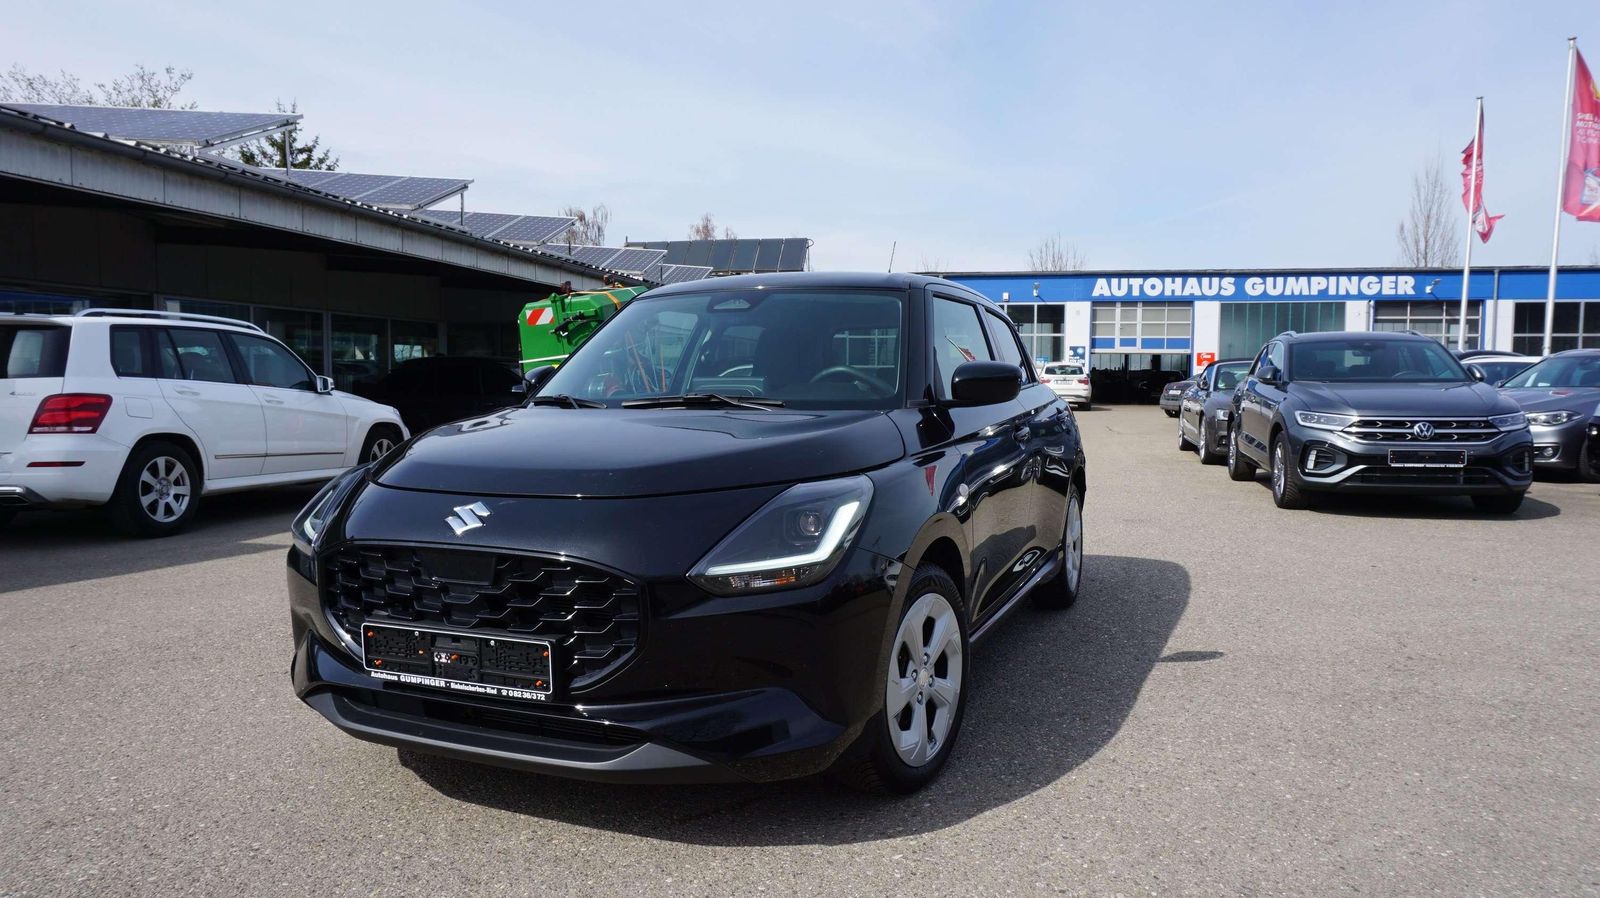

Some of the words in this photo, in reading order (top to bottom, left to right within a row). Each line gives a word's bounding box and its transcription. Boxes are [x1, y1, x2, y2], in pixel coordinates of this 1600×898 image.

[1092, 277, 1236, 296] AUTOHAUS
[1244, 276, 1416, 296] GUMPINGER
[370, 671, 398, 681] Autohaus
[400, 674, 446, 687] GUMPINGER
